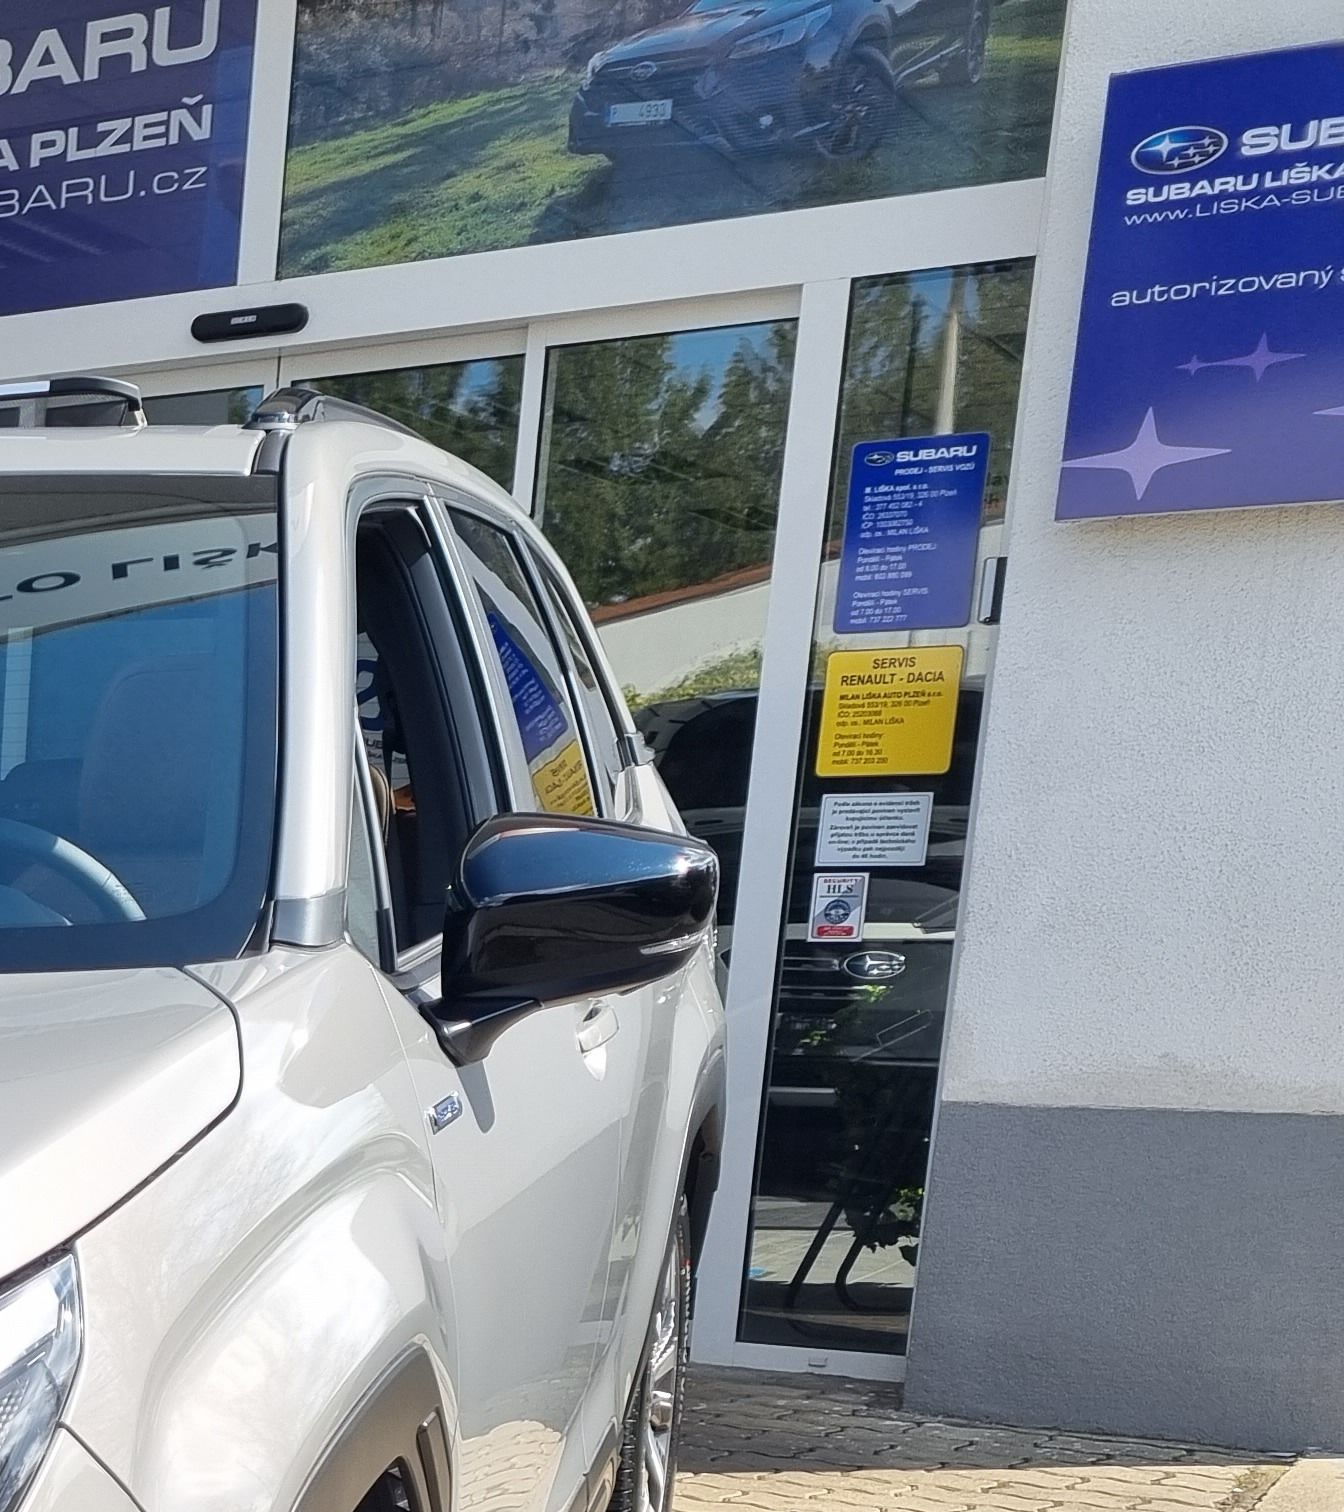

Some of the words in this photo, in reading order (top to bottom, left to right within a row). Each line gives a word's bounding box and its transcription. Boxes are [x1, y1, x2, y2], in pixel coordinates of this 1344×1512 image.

[28, 94, 213, 169] PLZEŇ
[1125, 173, 1259, 206] SUBARU
[1110, 264, 1334, 308] autorizovaný
[896, 445, 977, 462] SUBARU
[872, 657, 916, 668] SERVIS
[841, 673, 896, 685] RENAULT
[907, 671, 944, 682] DACIA
[826, 884, 853, 893] HLS
